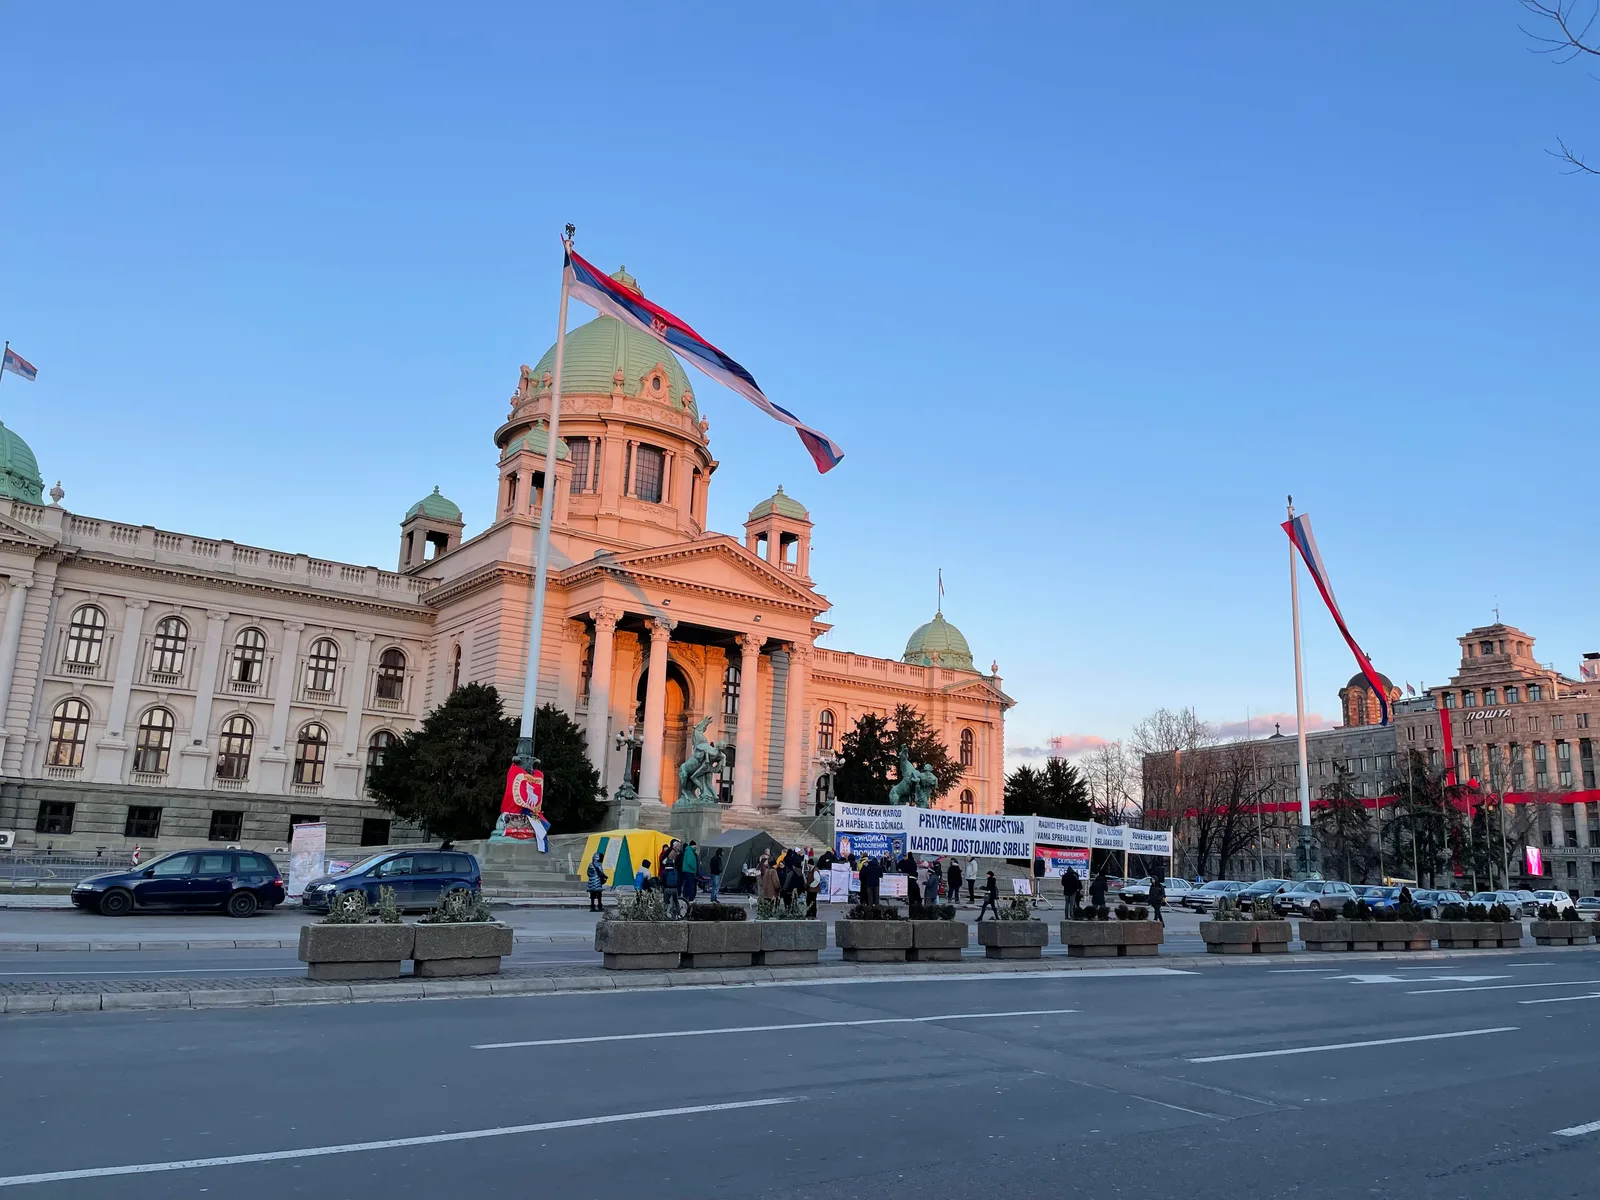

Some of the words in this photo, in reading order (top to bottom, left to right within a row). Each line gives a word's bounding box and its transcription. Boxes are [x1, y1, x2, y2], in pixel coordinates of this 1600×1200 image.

[1466, 709, 1511, 720] ПОШТА
[842, 807, 866, 816] POLICIJA
[866, 807, 882, 817] ČEKA
[883, 809, 902, 818] NAROD
[836, 819, 844, 828] ZA
[845, 818, 874, 830] HAPŠENJE
[919, 813, 977, 832] PRIVREMENA
[979, 817, 1024, 834] SKUPŠTINA
[1037, 832, 1051, 840] VAMA
[910, 836, 948, 852] NARODA
[951, 838, 1001, 856] DOSTOJNOG
[1002, 841, 1030, 857] SRBIJE
[1058, 869, 1087, 878] СРЈЕ
